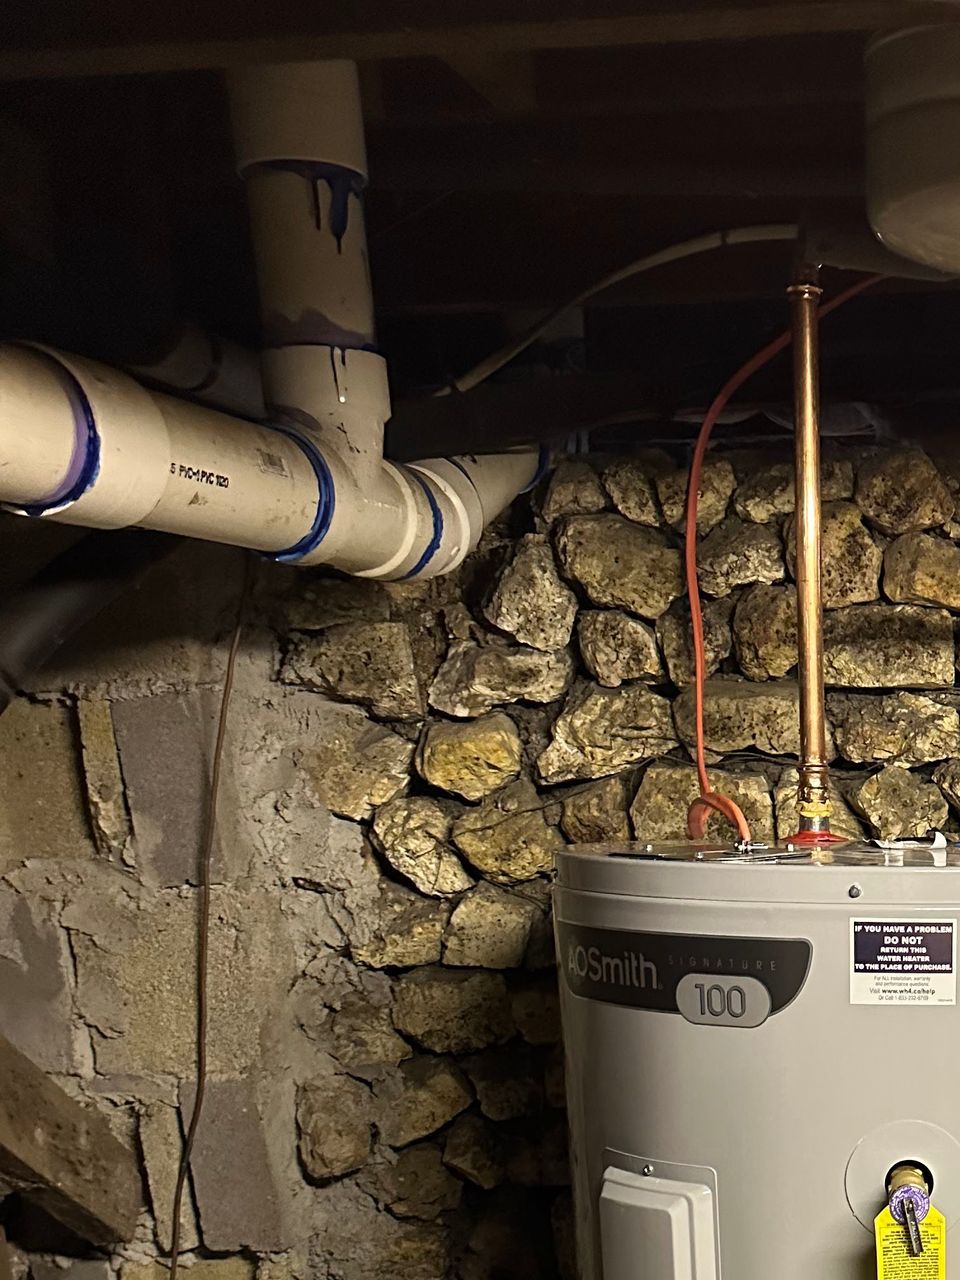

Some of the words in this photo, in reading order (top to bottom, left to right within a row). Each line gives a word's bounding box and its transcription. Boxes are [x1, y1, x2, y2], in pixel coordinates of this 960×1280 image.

[864, 925, 881, 933] YOU
[884, 936, 899, 945] DO
[901, 936, 924, 945] NOT
[567, 947, 658, 990] AOSmith
[667, 955, 778, 971] SIGNATURE
[695, 982, 747, 1018] 100
